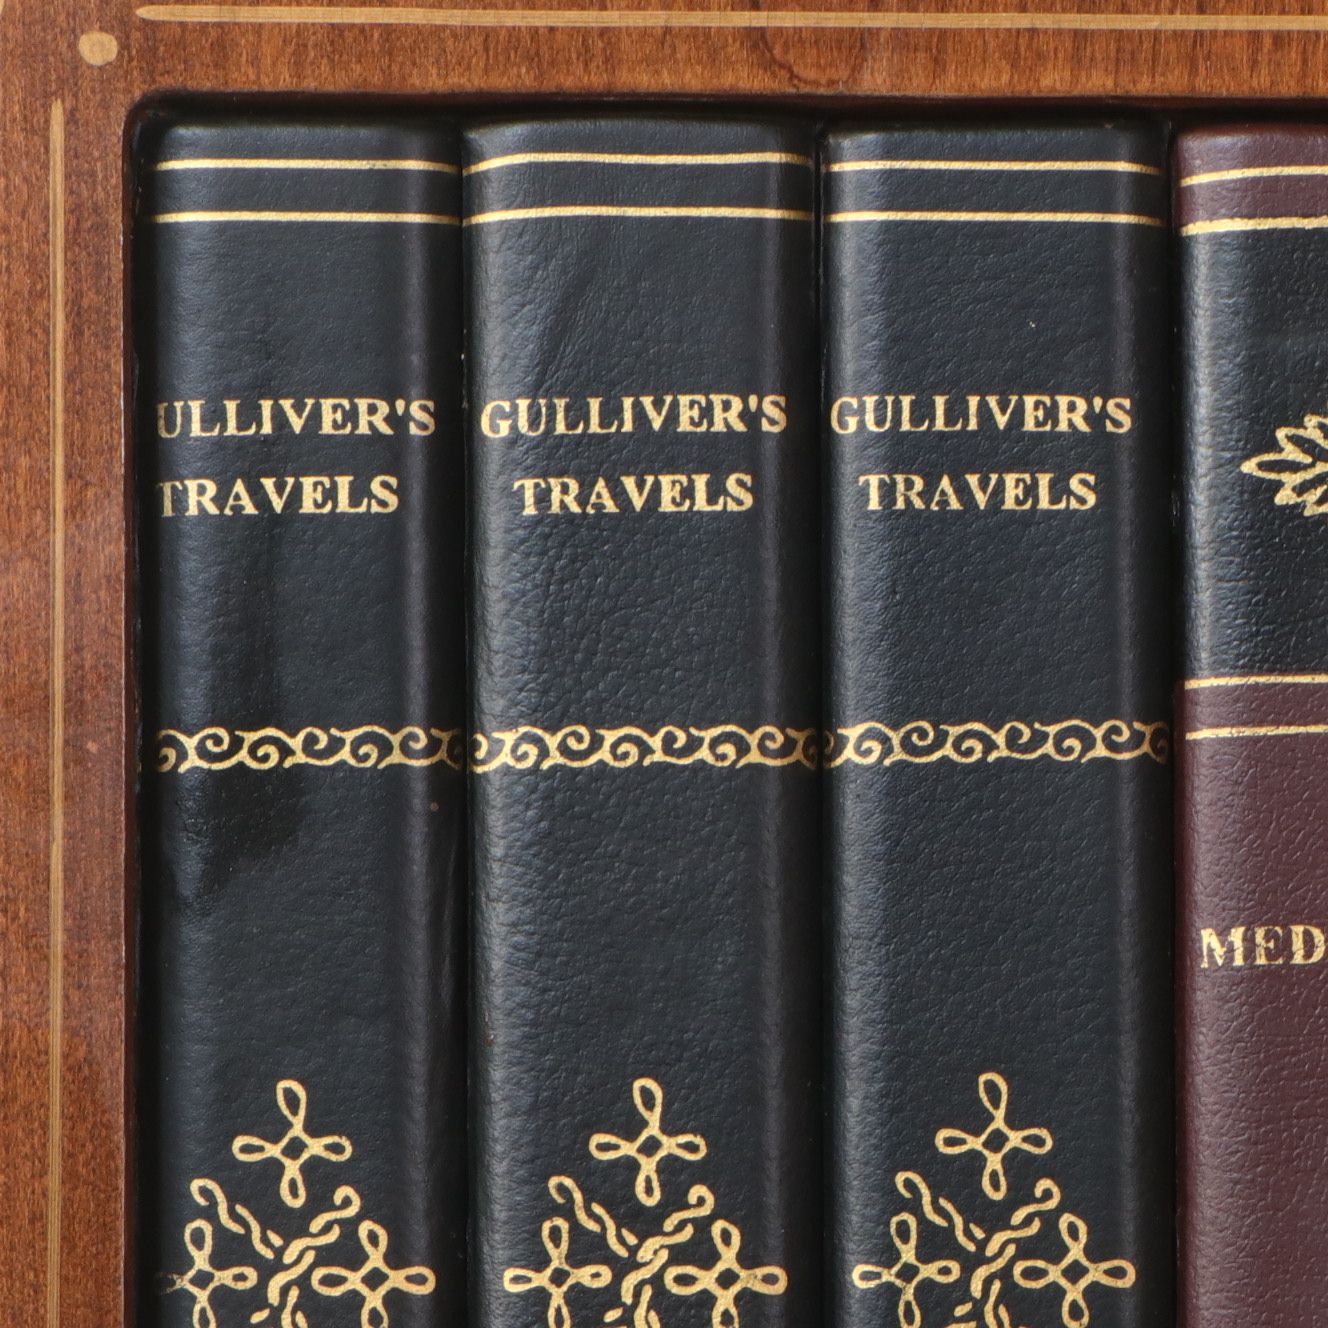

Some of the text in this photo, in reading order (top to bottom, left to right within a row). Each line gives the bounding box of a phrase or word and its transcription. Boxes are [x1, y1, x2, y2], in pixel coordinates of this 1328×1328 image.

[480, 394, 787, 438] GULLIVER'S
[830, 395, 1132, 434] GULLIVER'S
[156, 475, 398, 517] TRAVELS
[513, 473, 753, 515] TRAVELS
[858, 472, 1097, 510] TRAVELS
